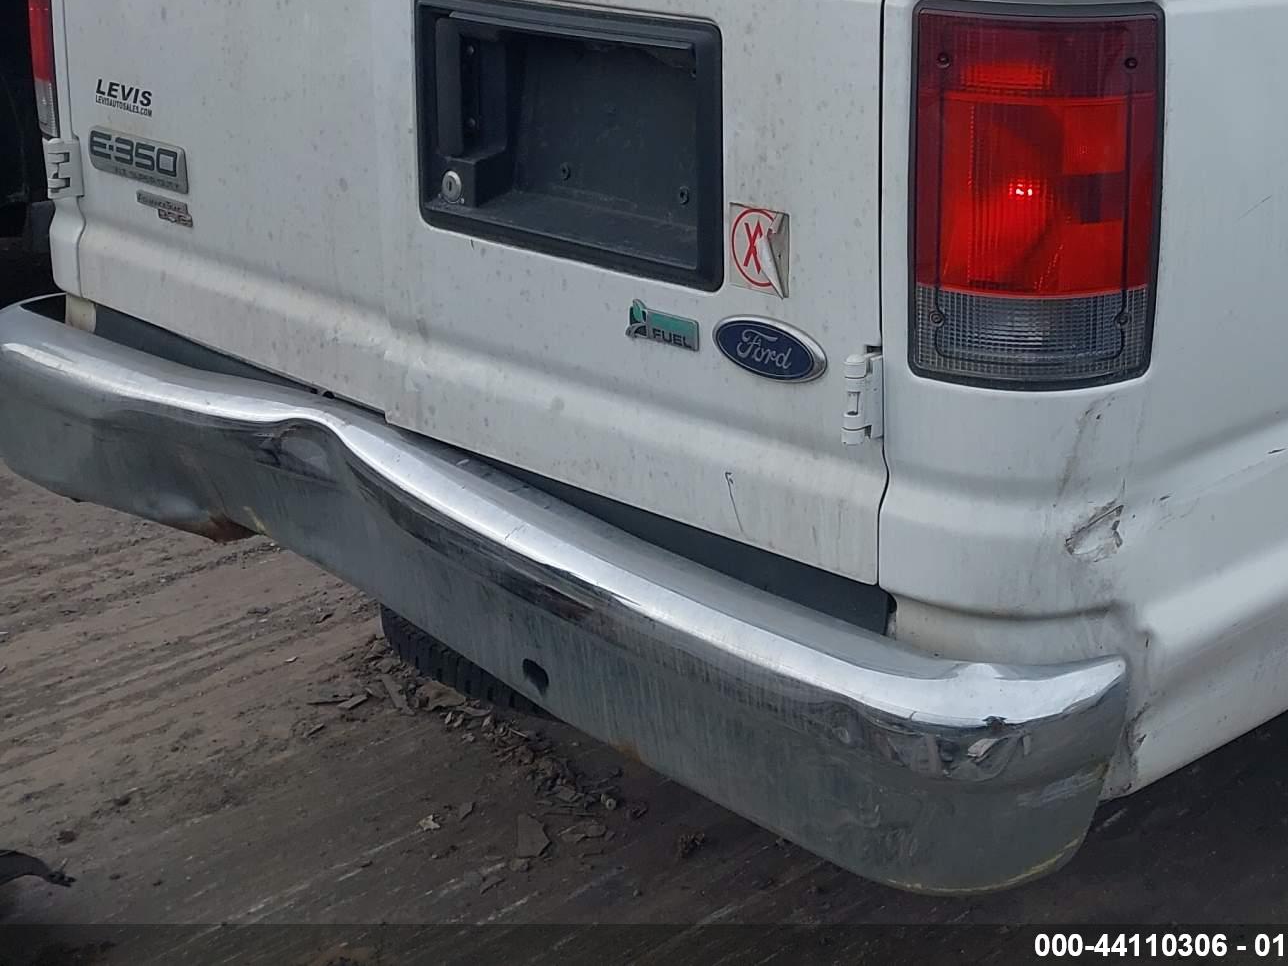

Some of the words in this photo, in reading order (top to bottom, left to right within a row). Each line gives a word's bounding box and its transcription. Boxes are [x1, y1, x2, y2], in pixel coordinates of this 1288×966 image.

[96, 78, 152, 106] LEVIS
[95, 94, 152, 117] LEVISAUTOSALES.COM
[652, 328, 692, 348] FUEL
[736, 328, 792, 370] Ford
